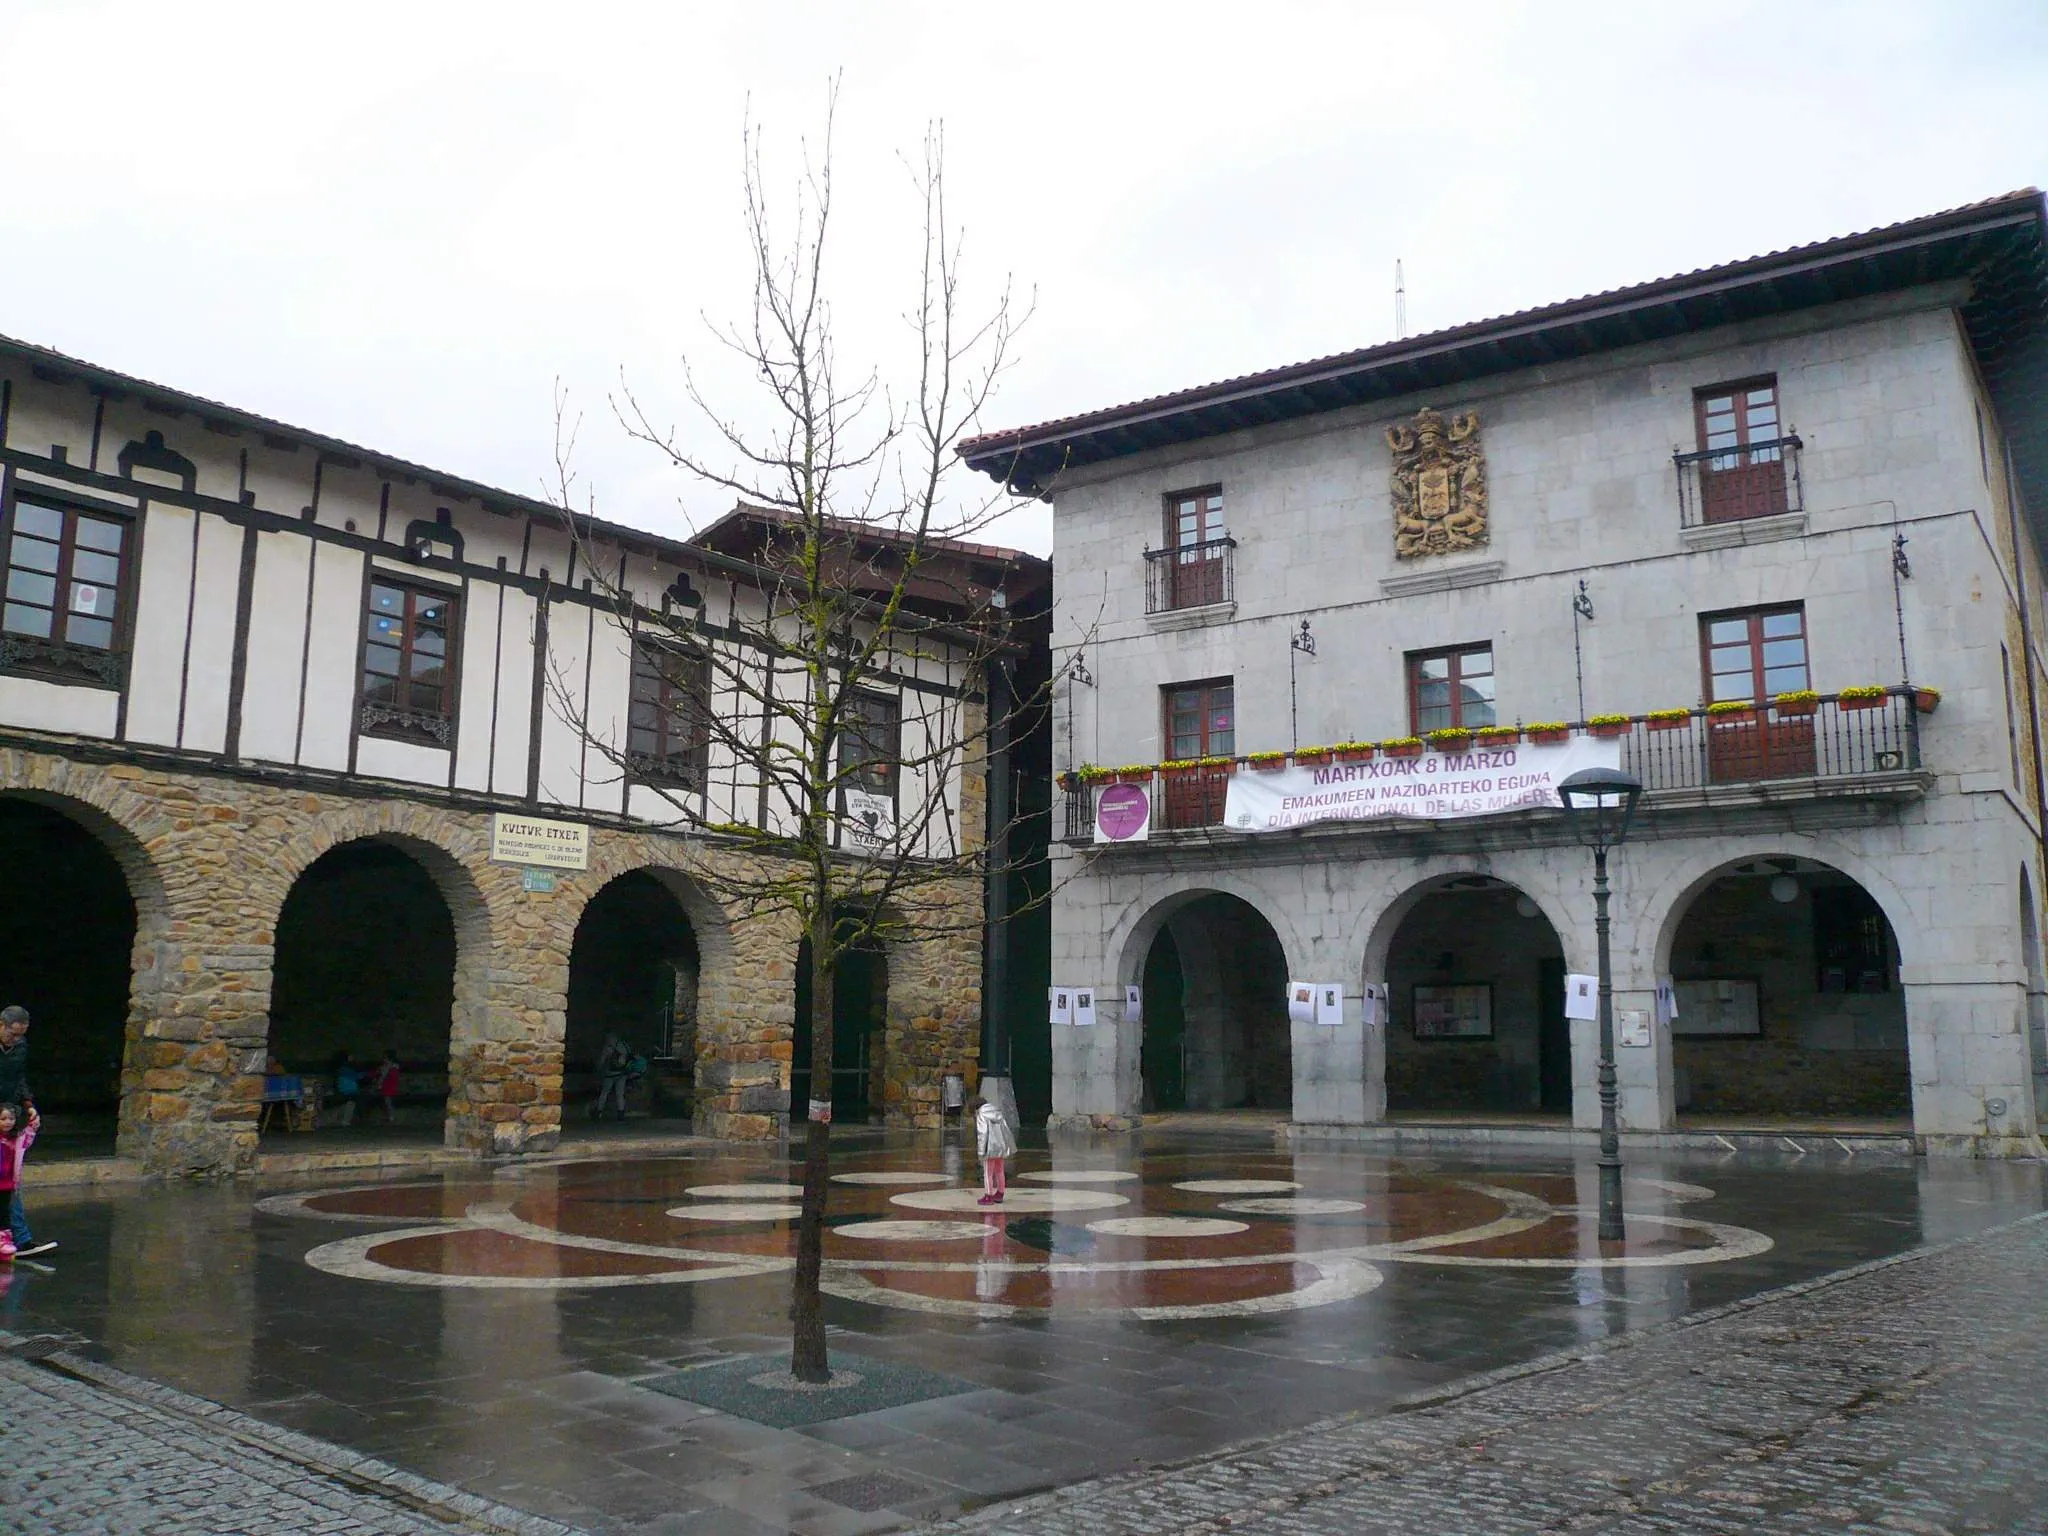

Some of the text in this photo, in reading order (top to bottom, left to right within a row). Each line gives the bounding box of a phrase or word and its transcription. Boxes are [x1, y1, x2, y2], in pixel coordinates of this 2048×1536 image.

[1313, 750, 1517, 785] MARTXOAK 8 MARZO
[1282, 771, 1551, 810] EMAKUMEEN NAZIOARTEKO EGUNA
[1426, 799, 1445, 814] DE
[1451, 797, 1482, 813] LAS
[546, 827, 580, 841] ETXEA
